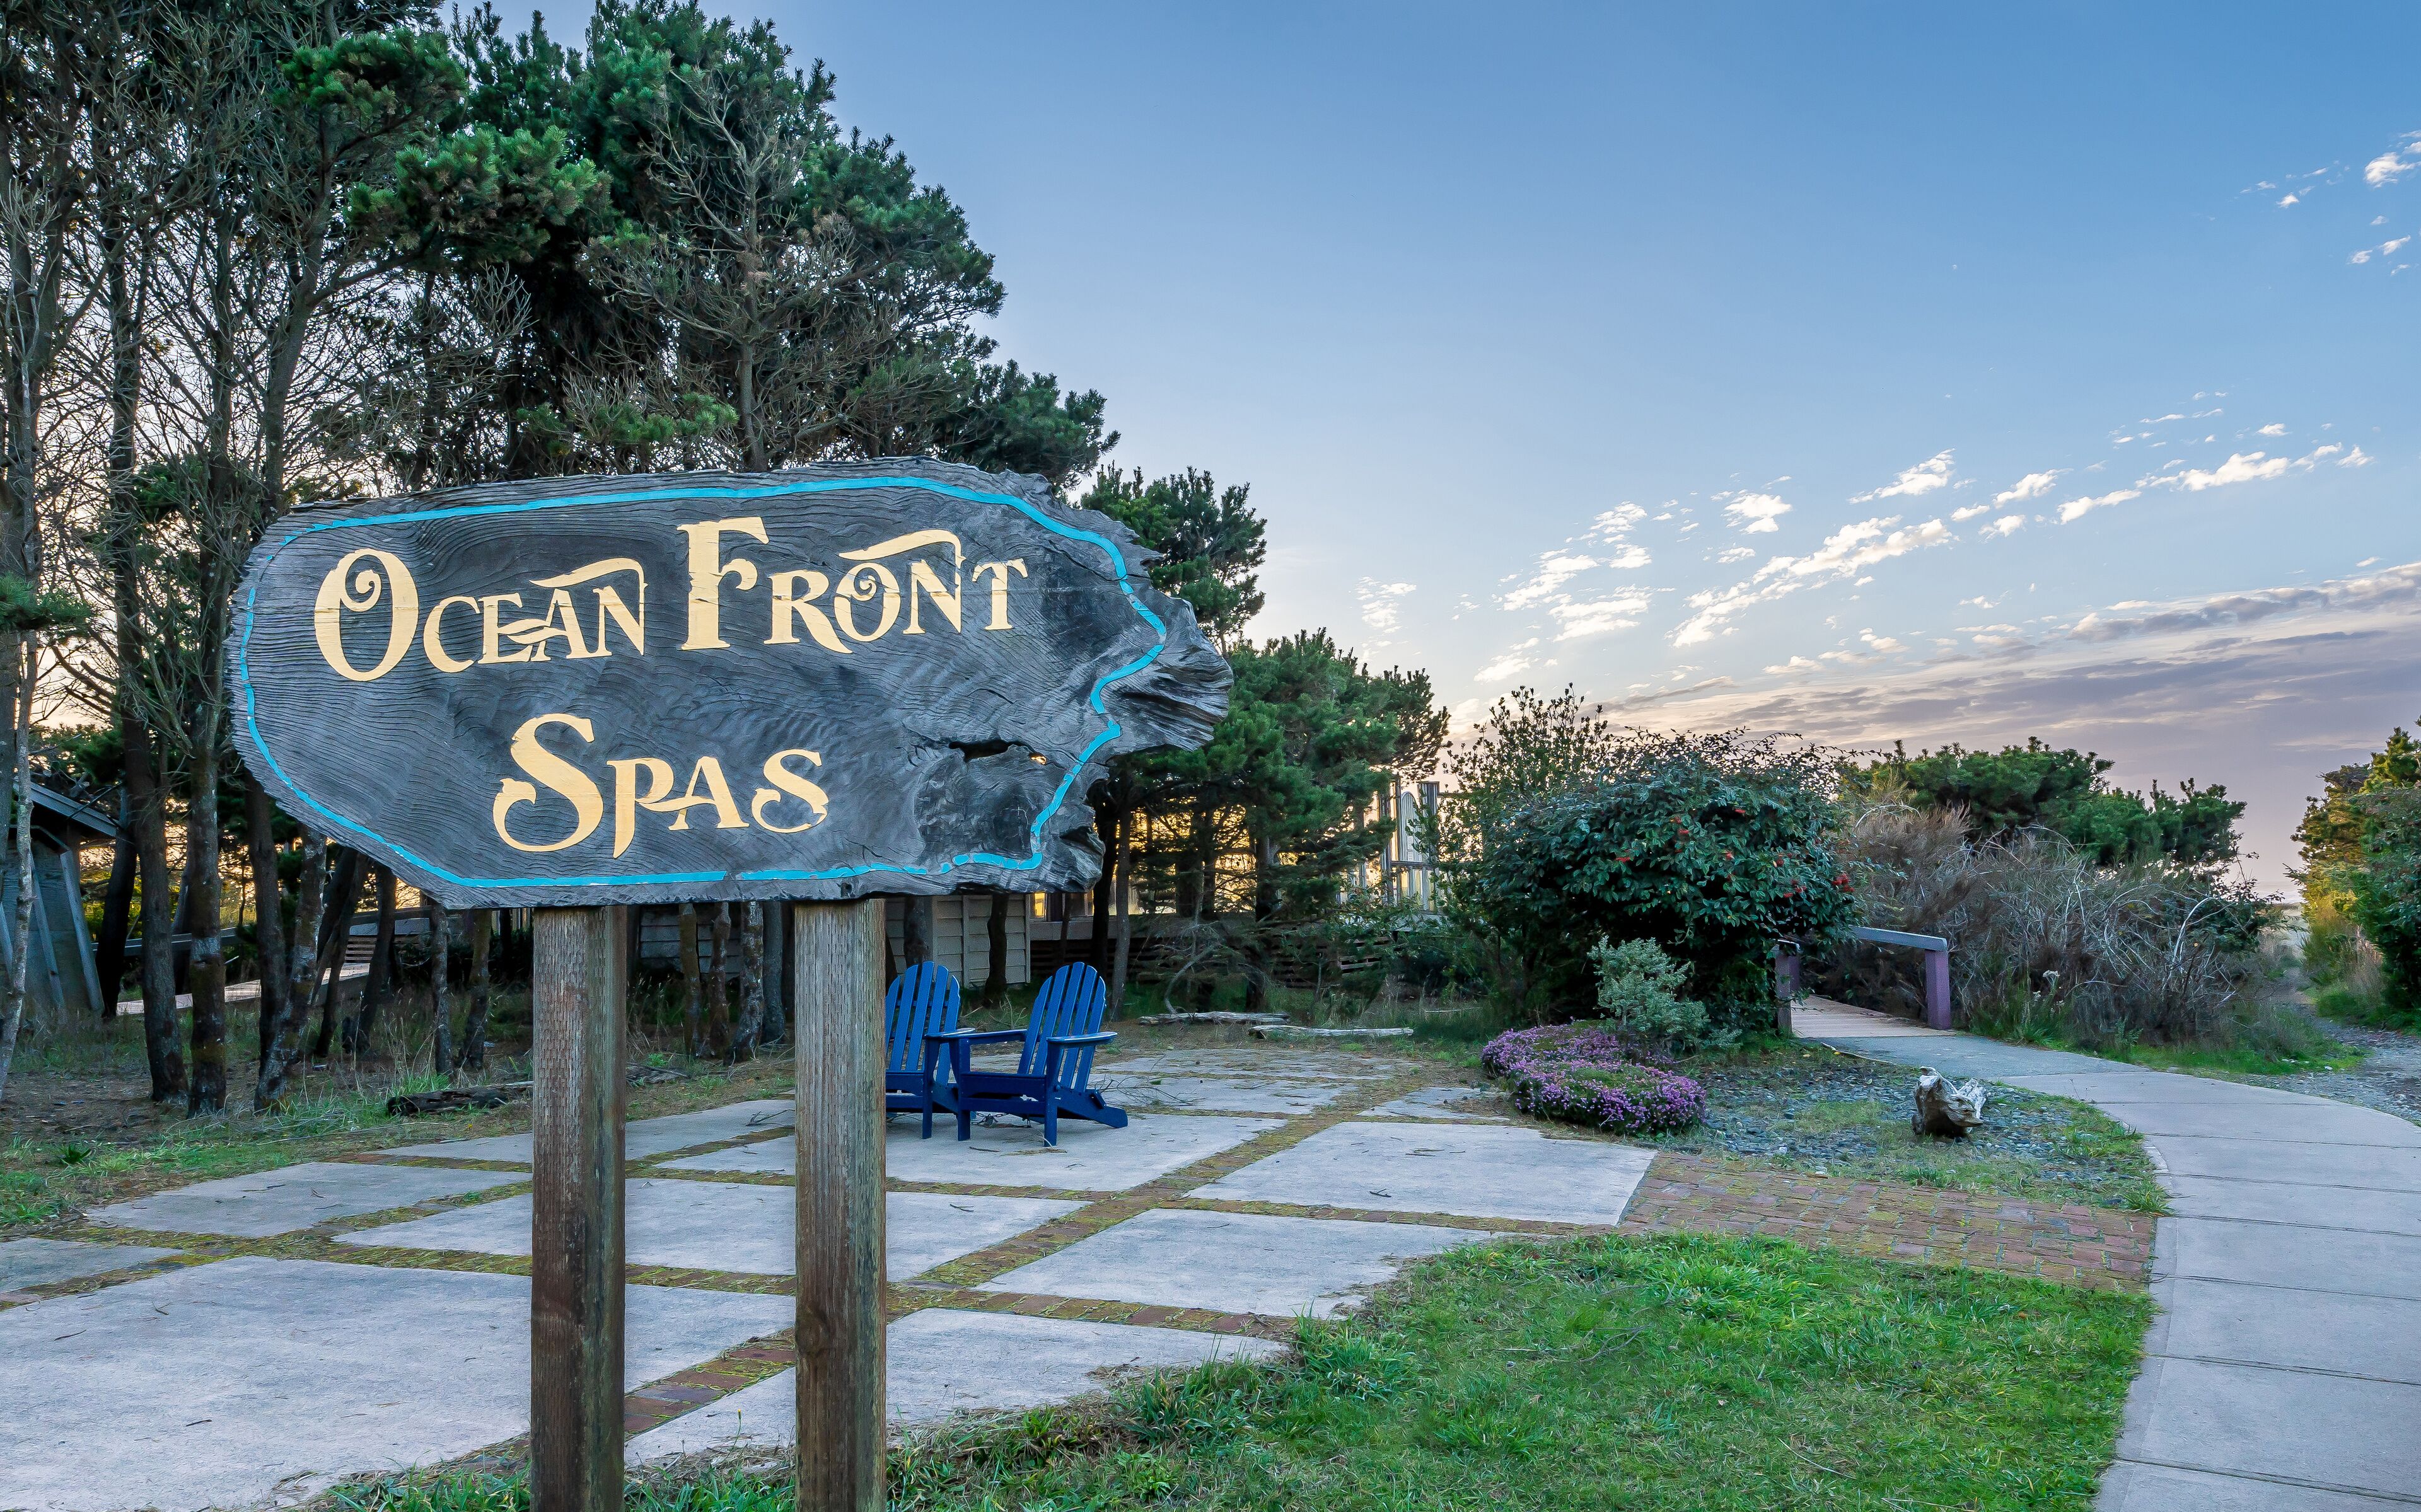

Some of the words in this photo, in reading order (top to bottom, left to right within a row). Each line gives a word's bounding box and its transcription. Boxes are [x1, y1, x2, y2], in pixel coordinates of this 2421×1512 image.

[315, 550, 646, 681] OCEAN
[678, 517, 1027, 653] FRONT
[494, 713, 828, 857] SPAS
